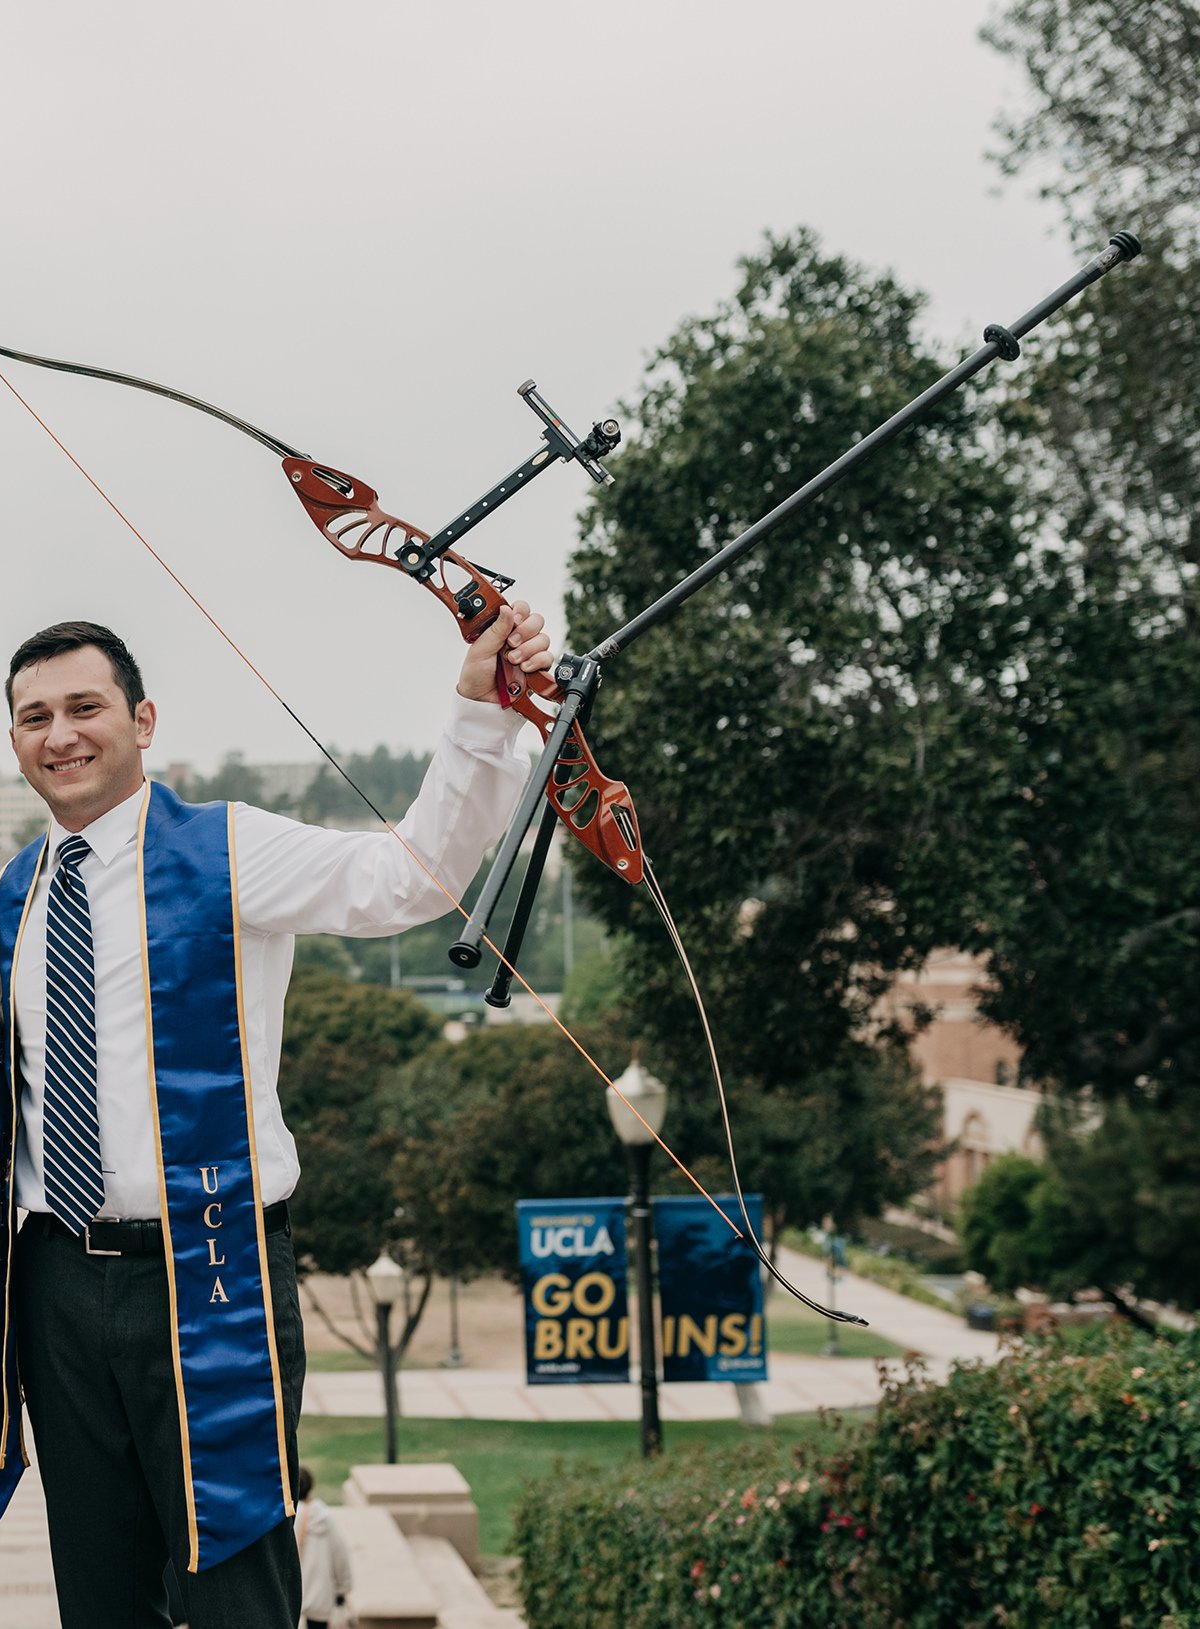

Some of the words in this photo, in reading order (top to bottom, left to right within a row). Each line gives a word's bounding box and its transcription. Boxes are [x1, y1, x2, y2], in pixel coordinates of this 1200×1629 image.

[199, 1166, 230, 1303] UCLA
[530, 1226, 615, 1258] UCLA
[531, 1271, 616, 1318] GO
